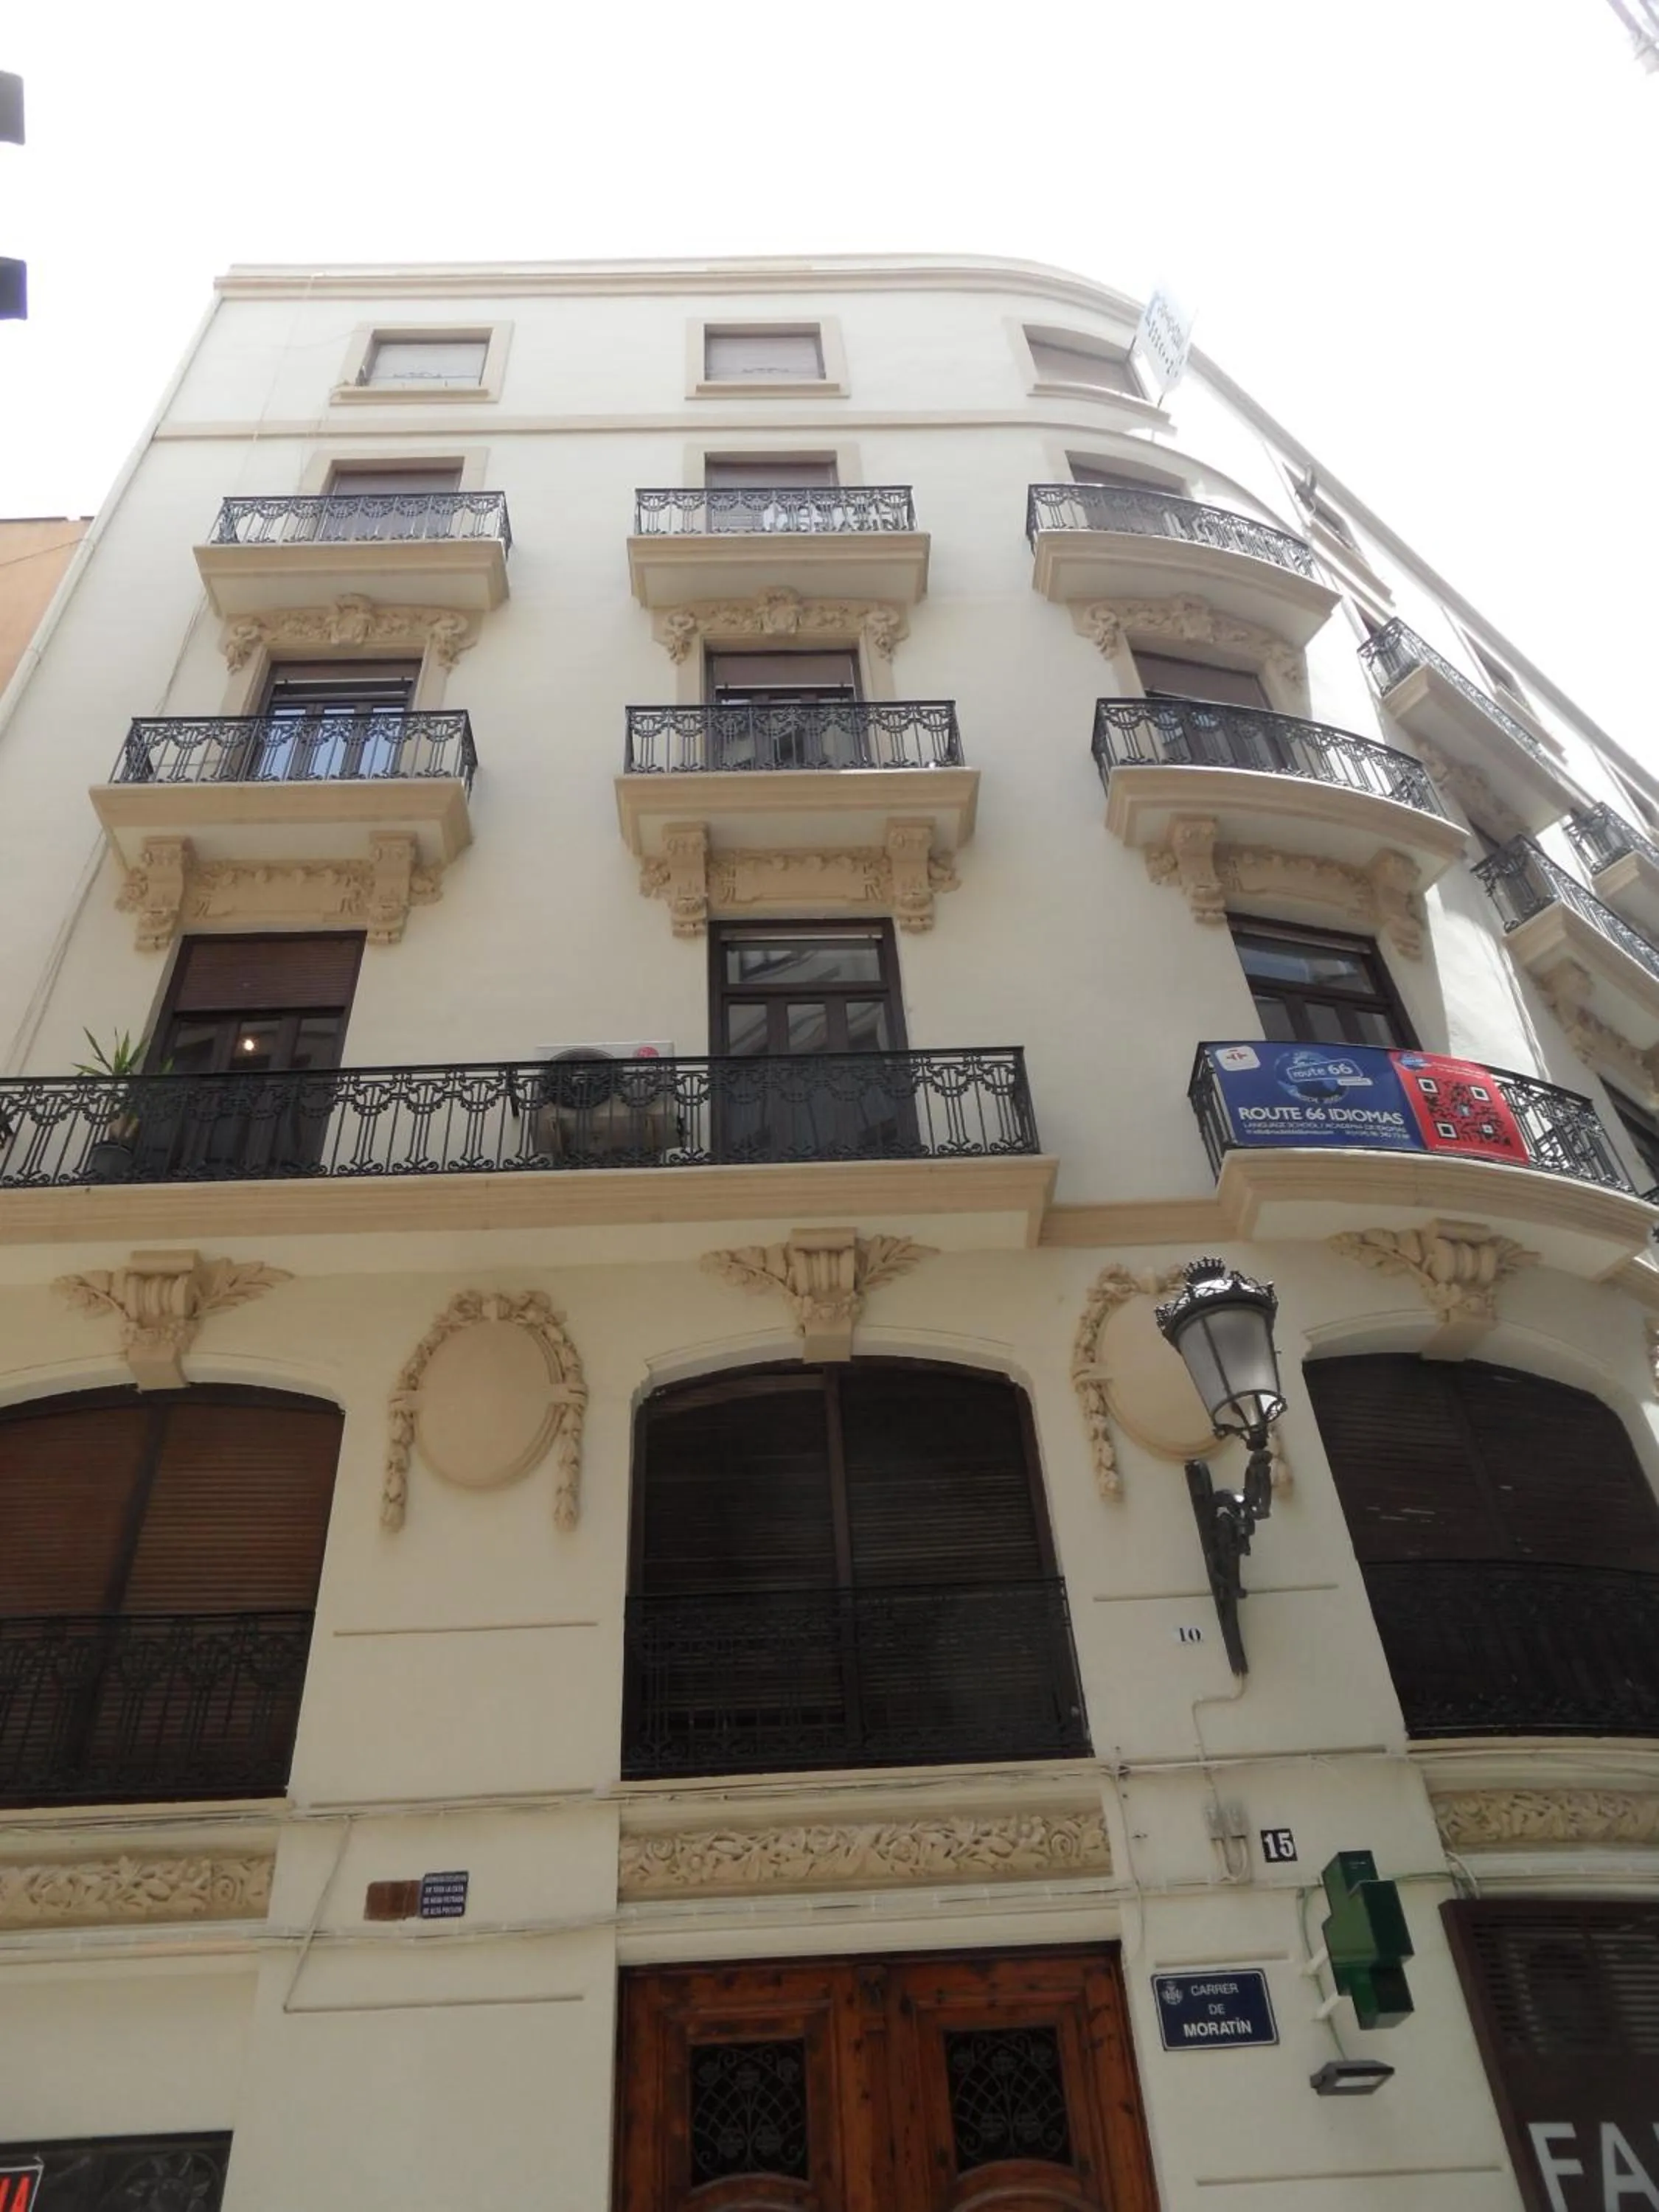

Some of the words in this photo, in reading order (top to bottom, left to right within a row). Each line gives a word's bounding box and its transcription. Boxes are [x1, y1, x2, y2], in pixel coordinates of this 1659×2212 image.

[1328, 1063, 1353, 1075] 66
[1238, 1107, 1303, 1120] ROUTE
[1306, 1107, 1326, 1120] 66
[1328, 1108, 1405, 1124] IDIOMAS
[1179, 1627, 1201, 1643] 10
[1264, 1832, 1295, 1859] 15
[1191, 1983, 1239, 1996] CARRER
[1208, 2003, 1225, 2015] DE
[1183, 2017, 1253, 2038] MORATÍN
[1527, 2121, 1659, 2212] FA
